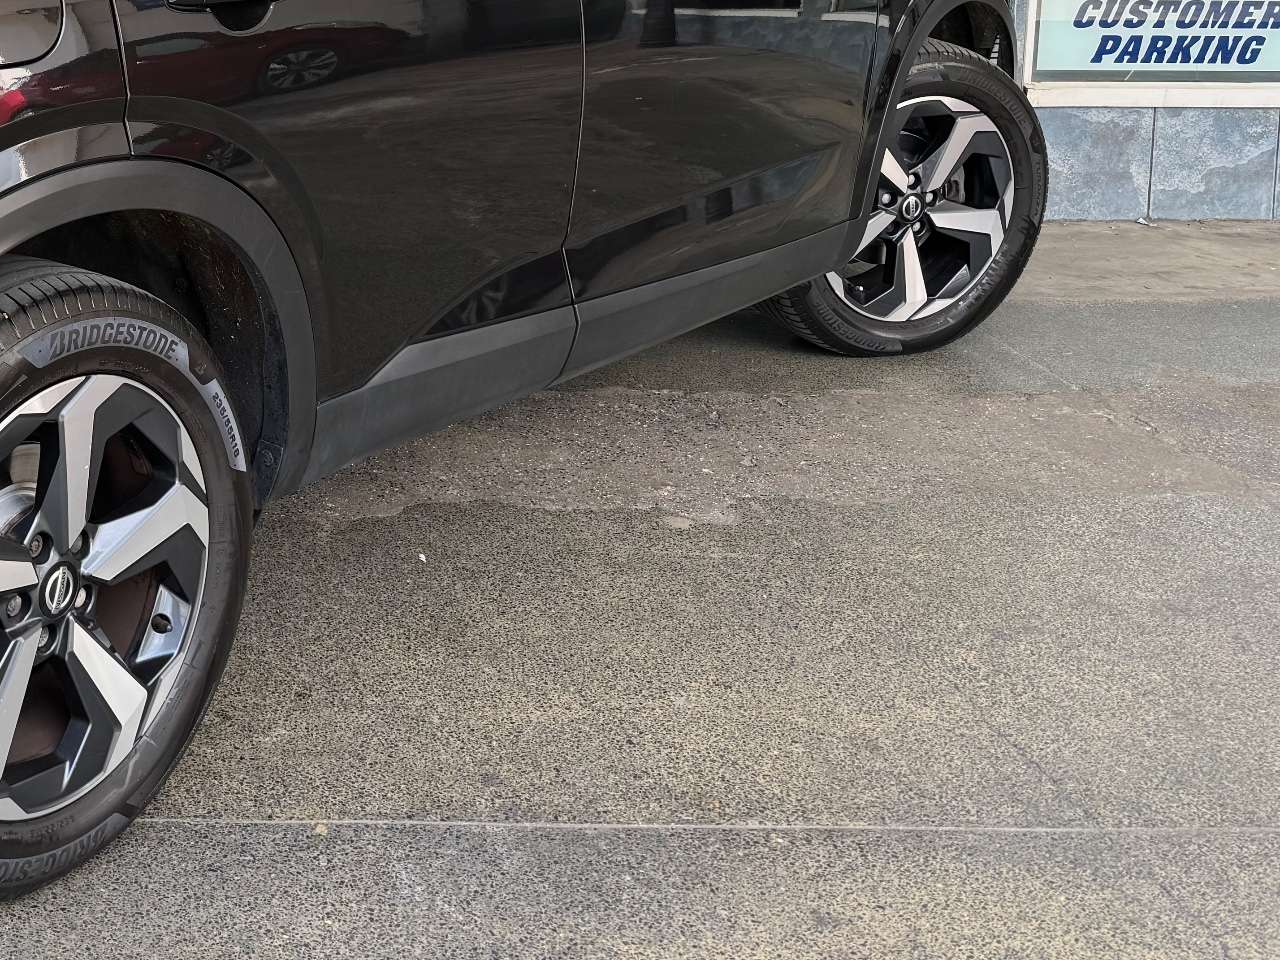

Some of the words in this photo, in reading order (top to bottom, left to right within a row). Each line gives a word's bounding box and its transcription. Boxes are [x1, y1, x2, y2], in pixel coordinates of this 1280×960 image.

[1073, 0, 1280, 29] CUSTOMER
[1090, 34, 1267, 65] PARKING
[49, 322, 179, 360] BRIDGESTONE
